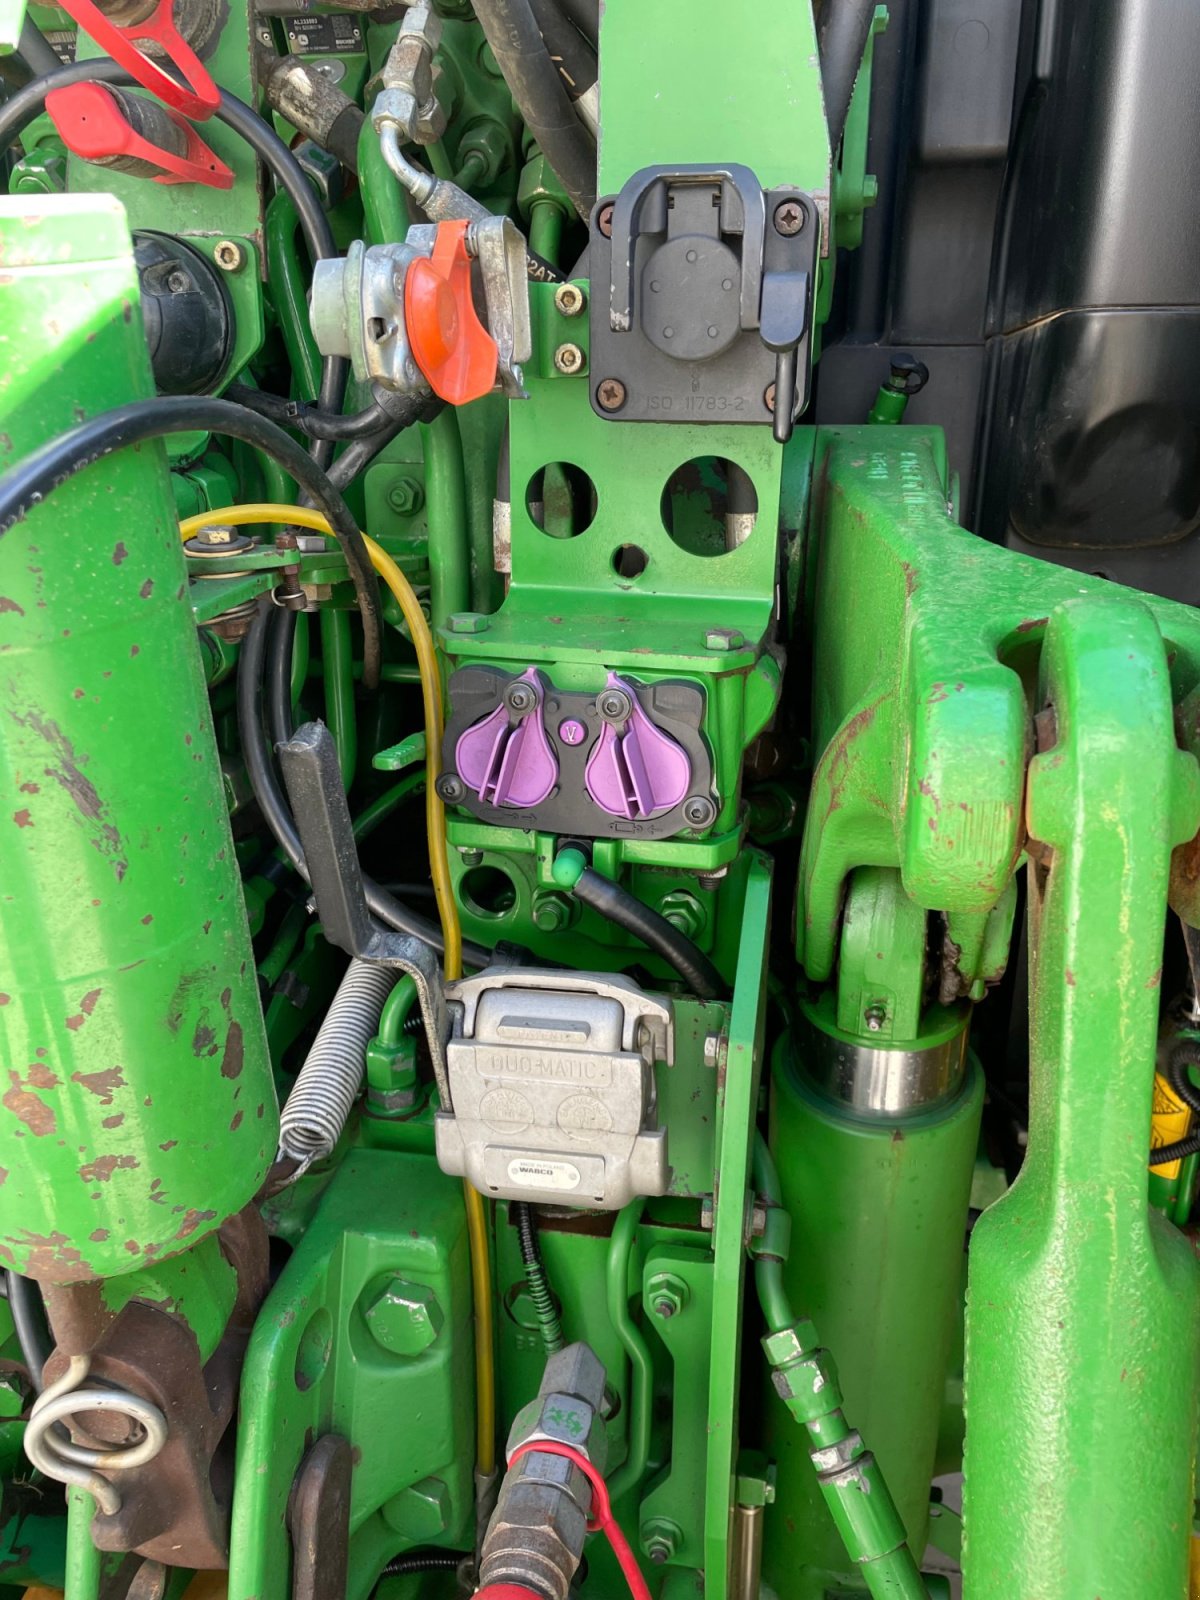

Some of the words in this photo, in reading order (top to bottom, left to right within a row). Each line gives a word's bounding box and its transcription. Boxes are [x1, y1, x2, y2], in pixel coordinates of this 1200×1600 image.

[647, 396, 673, 410] ISO
[686, 396, 745, 411] 11783-2
[565, 726, 577, 742] V
[519, 1166, 554, 1176] WABCO
